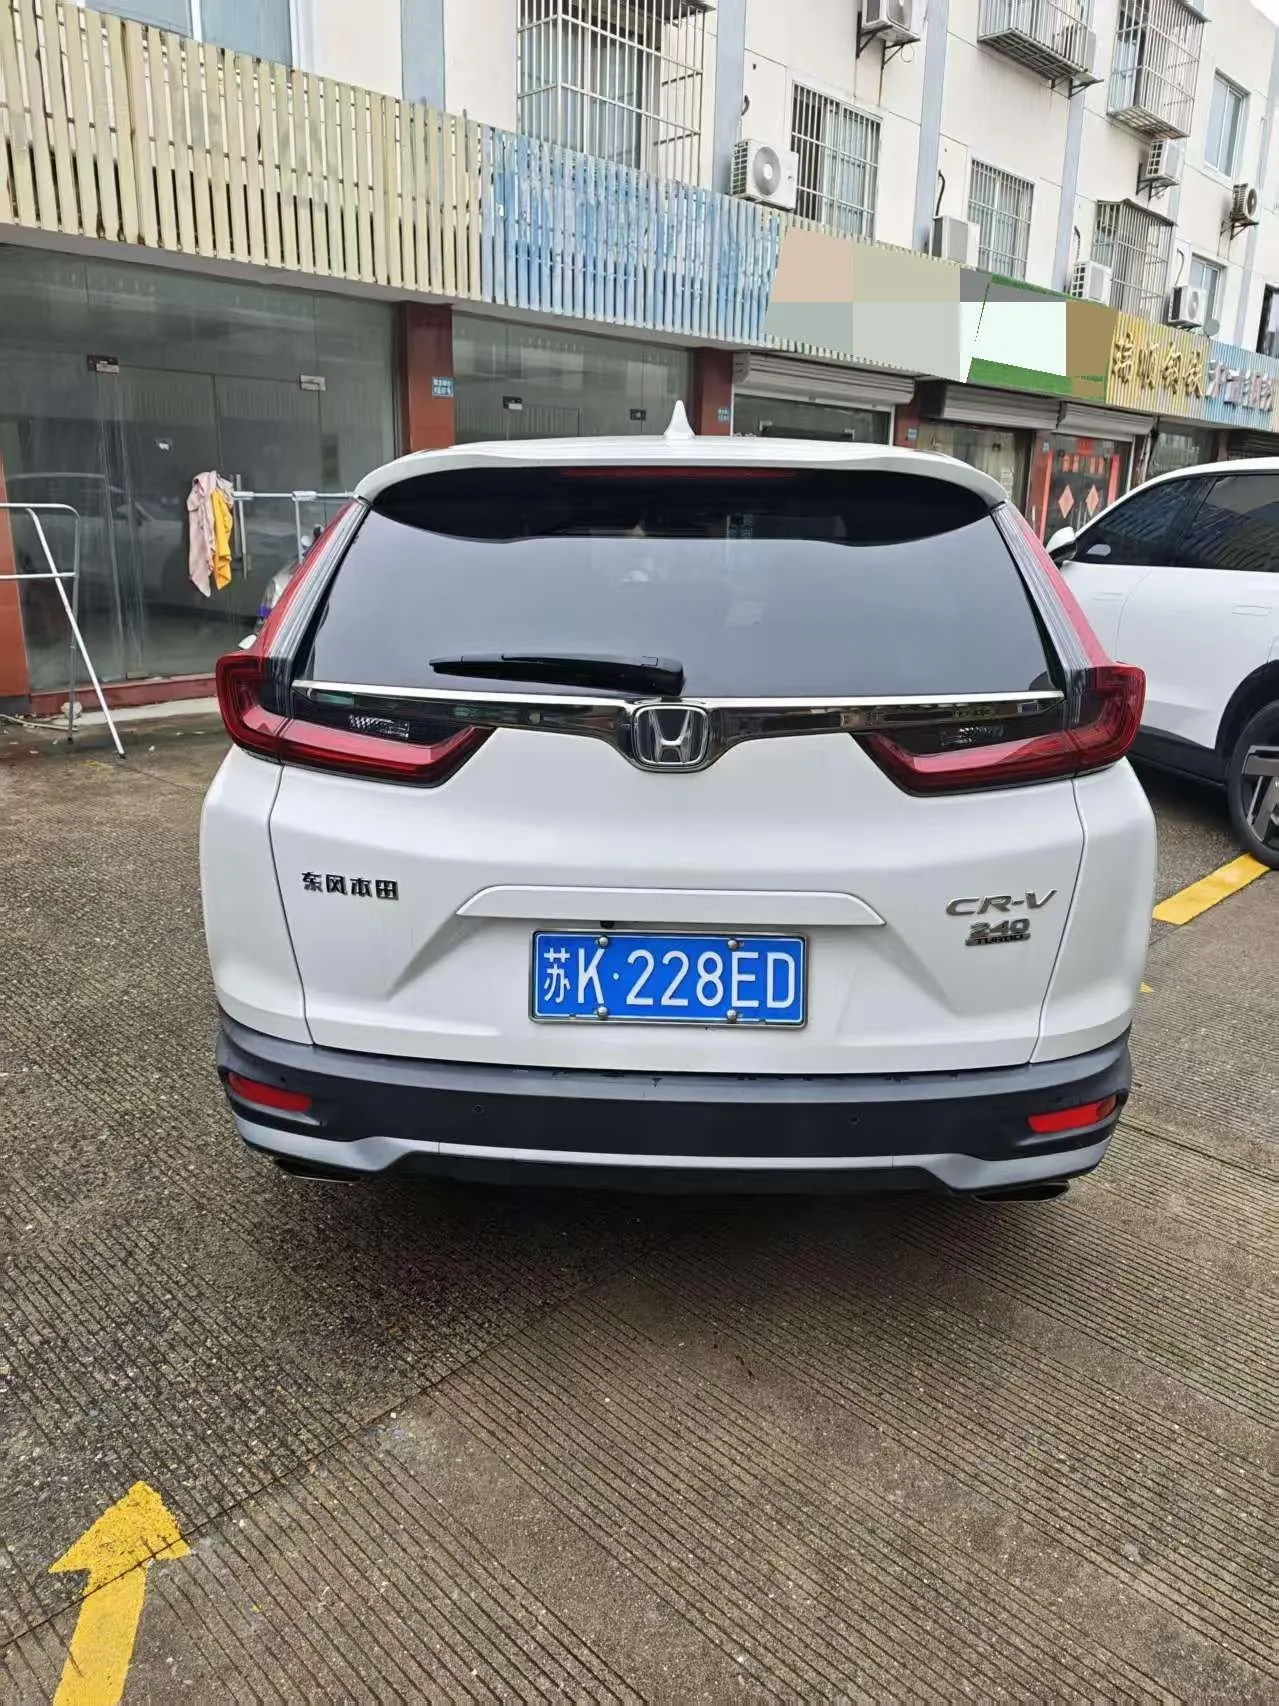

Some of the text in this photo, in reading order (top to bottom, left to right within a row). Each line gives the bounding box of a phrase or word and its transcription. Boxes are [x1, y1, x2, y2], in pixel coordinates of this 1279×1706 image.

[302, 872, 399, 901] 东风本田
[946, 888, 1057, 916] CR-V
[970, 918, 1030, 938] 240
